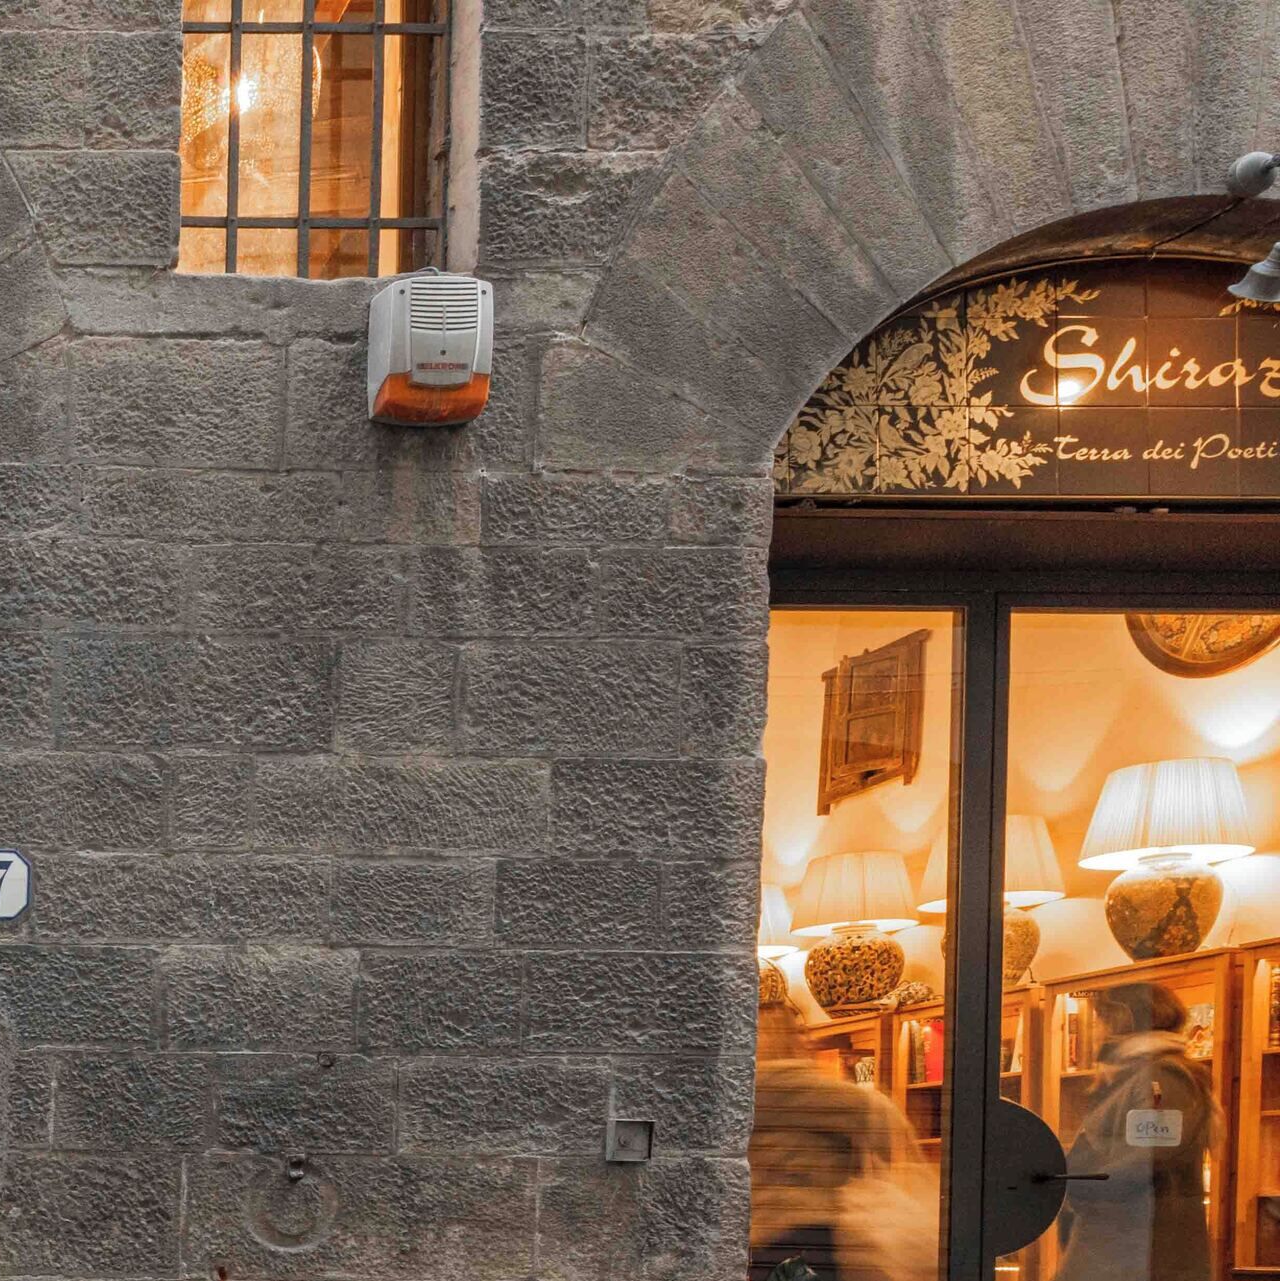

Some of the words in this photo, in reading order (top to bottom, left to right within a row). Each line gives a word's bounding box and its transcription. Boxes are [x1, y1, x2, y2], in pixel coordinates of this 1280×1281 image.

[1019, 324, 1280, 406] Shiraz
[1053, 434, 1133, 461] Terra
[1142, 439, 1186, 461] dei
[1189, 433, 1279, 470] Poeti
